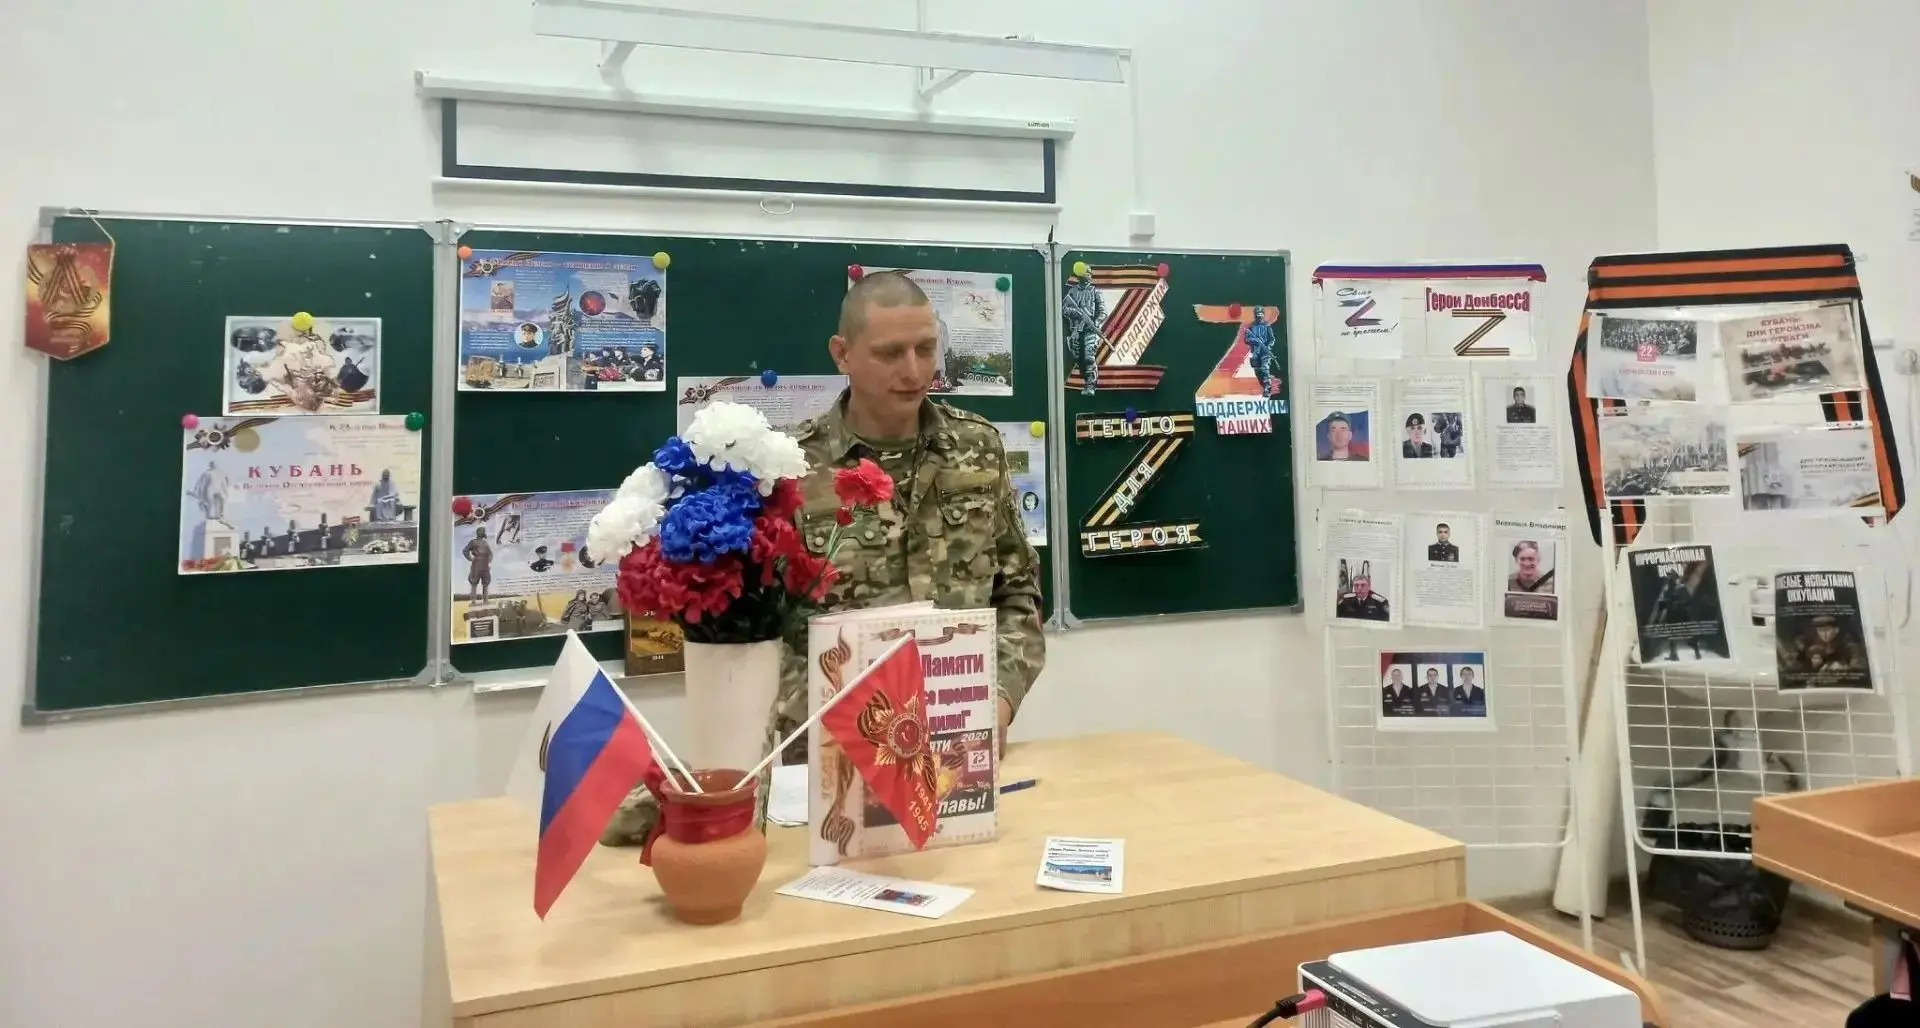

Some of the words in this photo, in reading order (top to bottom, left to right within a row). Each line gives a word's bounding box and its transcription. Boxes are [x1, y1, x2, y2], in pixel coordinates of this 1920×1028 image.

[1425, 286, 1462, 312] Герои
[1463, 291, 1531, 312] Донбасса
[1115, 281, 1169, 362] ПОДДЕРЖИМ
[1769, 322, 1822, 336] ГЕРОИЗМА
[1640, 344, 1653, 357] 22
[1195, 400, 1289, 419] ПОДДЕРЖИМ
[1085, 415, 1176, 438] ТЕПЛО
[1216, 418, 1273, 435] НАШИХ!
[248, 463, 363, 479] КУБАНЬ
[1112, 460, 1155, 514] ДЛЯ
[1086, 523, 1192, 552] ГЕРОЯ
[1634, 548, 1706, 566] ИНФОРМАЦИОННАЯ
[961, 730, 988, 743] 2020
[936, 791, 987, 816] лавы!
[908, 799, 930, 833] 1945
